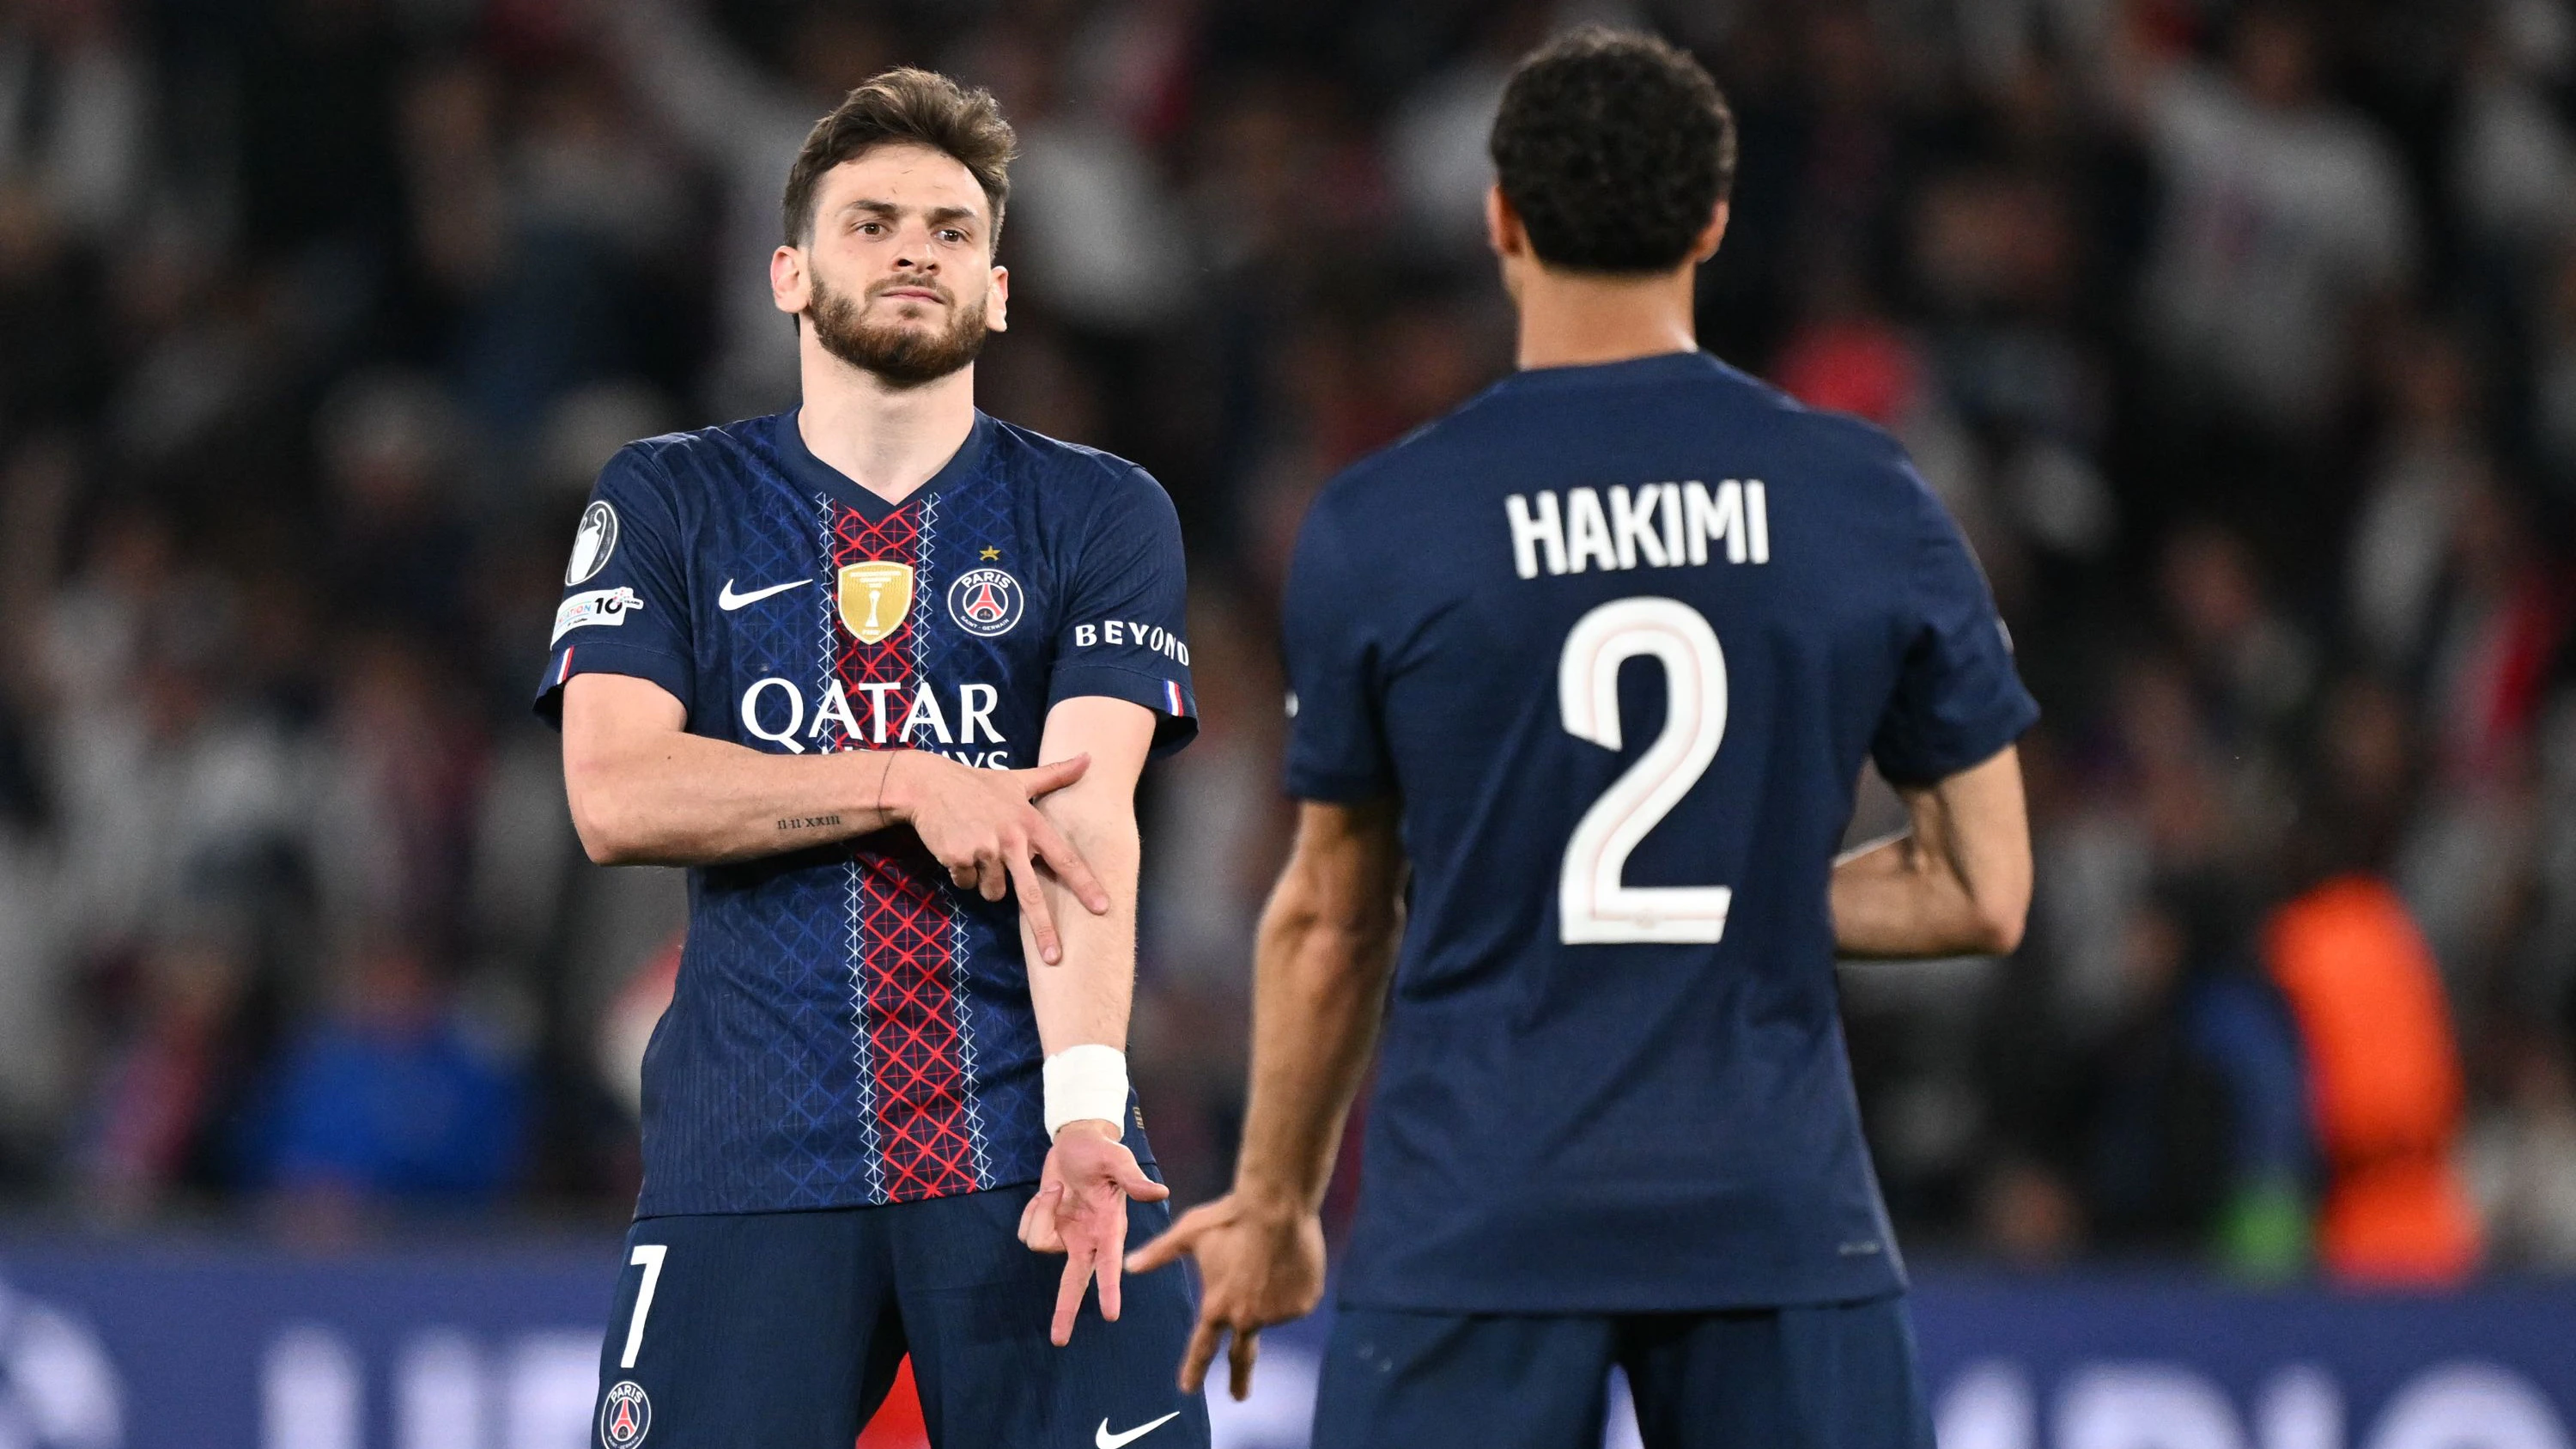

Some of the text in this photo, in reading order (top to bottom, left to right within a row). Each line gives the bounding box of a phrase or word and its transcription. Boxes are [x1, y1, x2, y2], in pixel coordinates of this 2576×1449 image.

[1505, 478, 1770, 580] HAKIMI
[961, 571, 1012, 589] PARIS
[1075, 620, 1189, 667] BEYOND
[741, 677, 1006, 754] QATAR
[1558, 595, 1733, 945] 2
[621, 1245, 668, 1368] 7
[611, 1385, 643, 1404] PARIS
